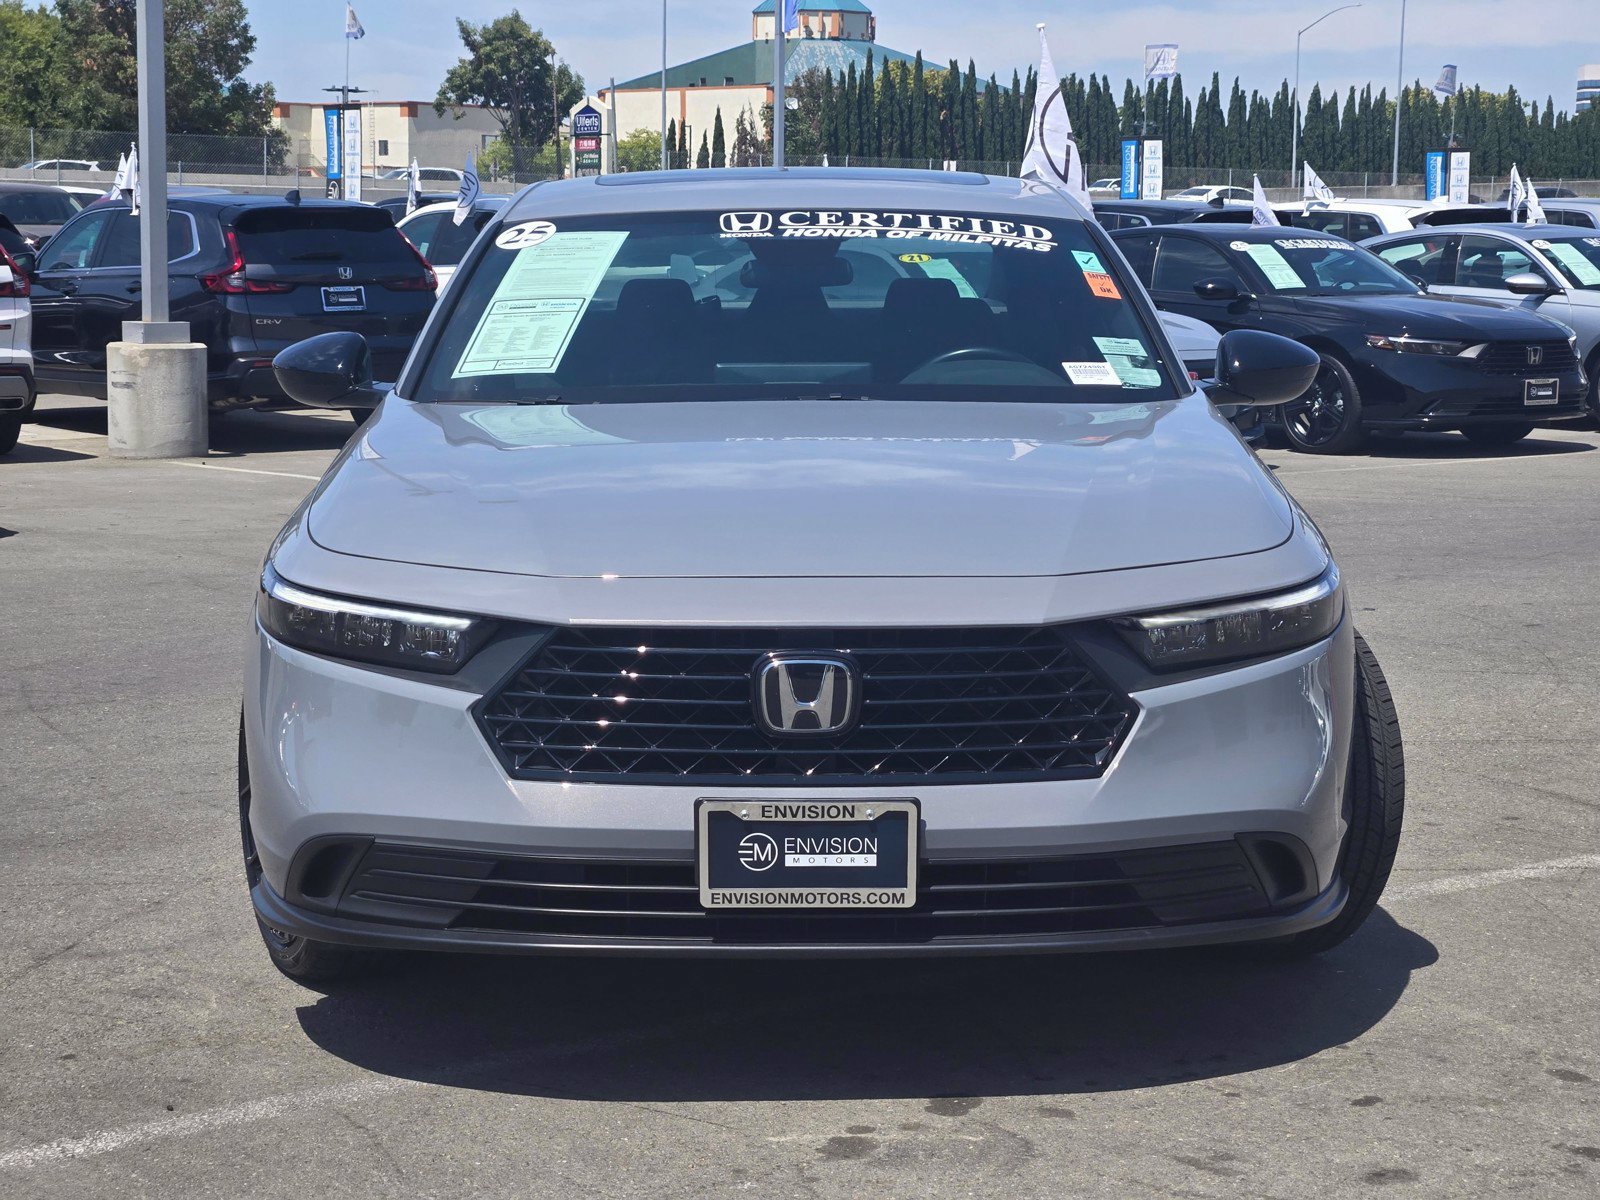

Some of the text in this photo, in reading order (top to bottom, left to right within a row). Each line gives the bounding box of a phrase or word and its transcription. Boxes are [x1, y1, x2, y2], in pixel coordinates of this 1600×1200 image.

[779, 211, 1053, 241] CERTIFIED
[502, 224, 553, 245] 25
[782, 228, 1053, 252] HONDA OF MILPITAS
[908, 254, 924, 262] 21
[1087, 272, 1111, 282] SAFETY
[1099, 286, 1114, 294] OK
[761, 805, 856, 819] ENVISION
[784, 837, 878, 853] ENVISION
[711, 892, 905, 905] ENVISIONMOTORS.COM
